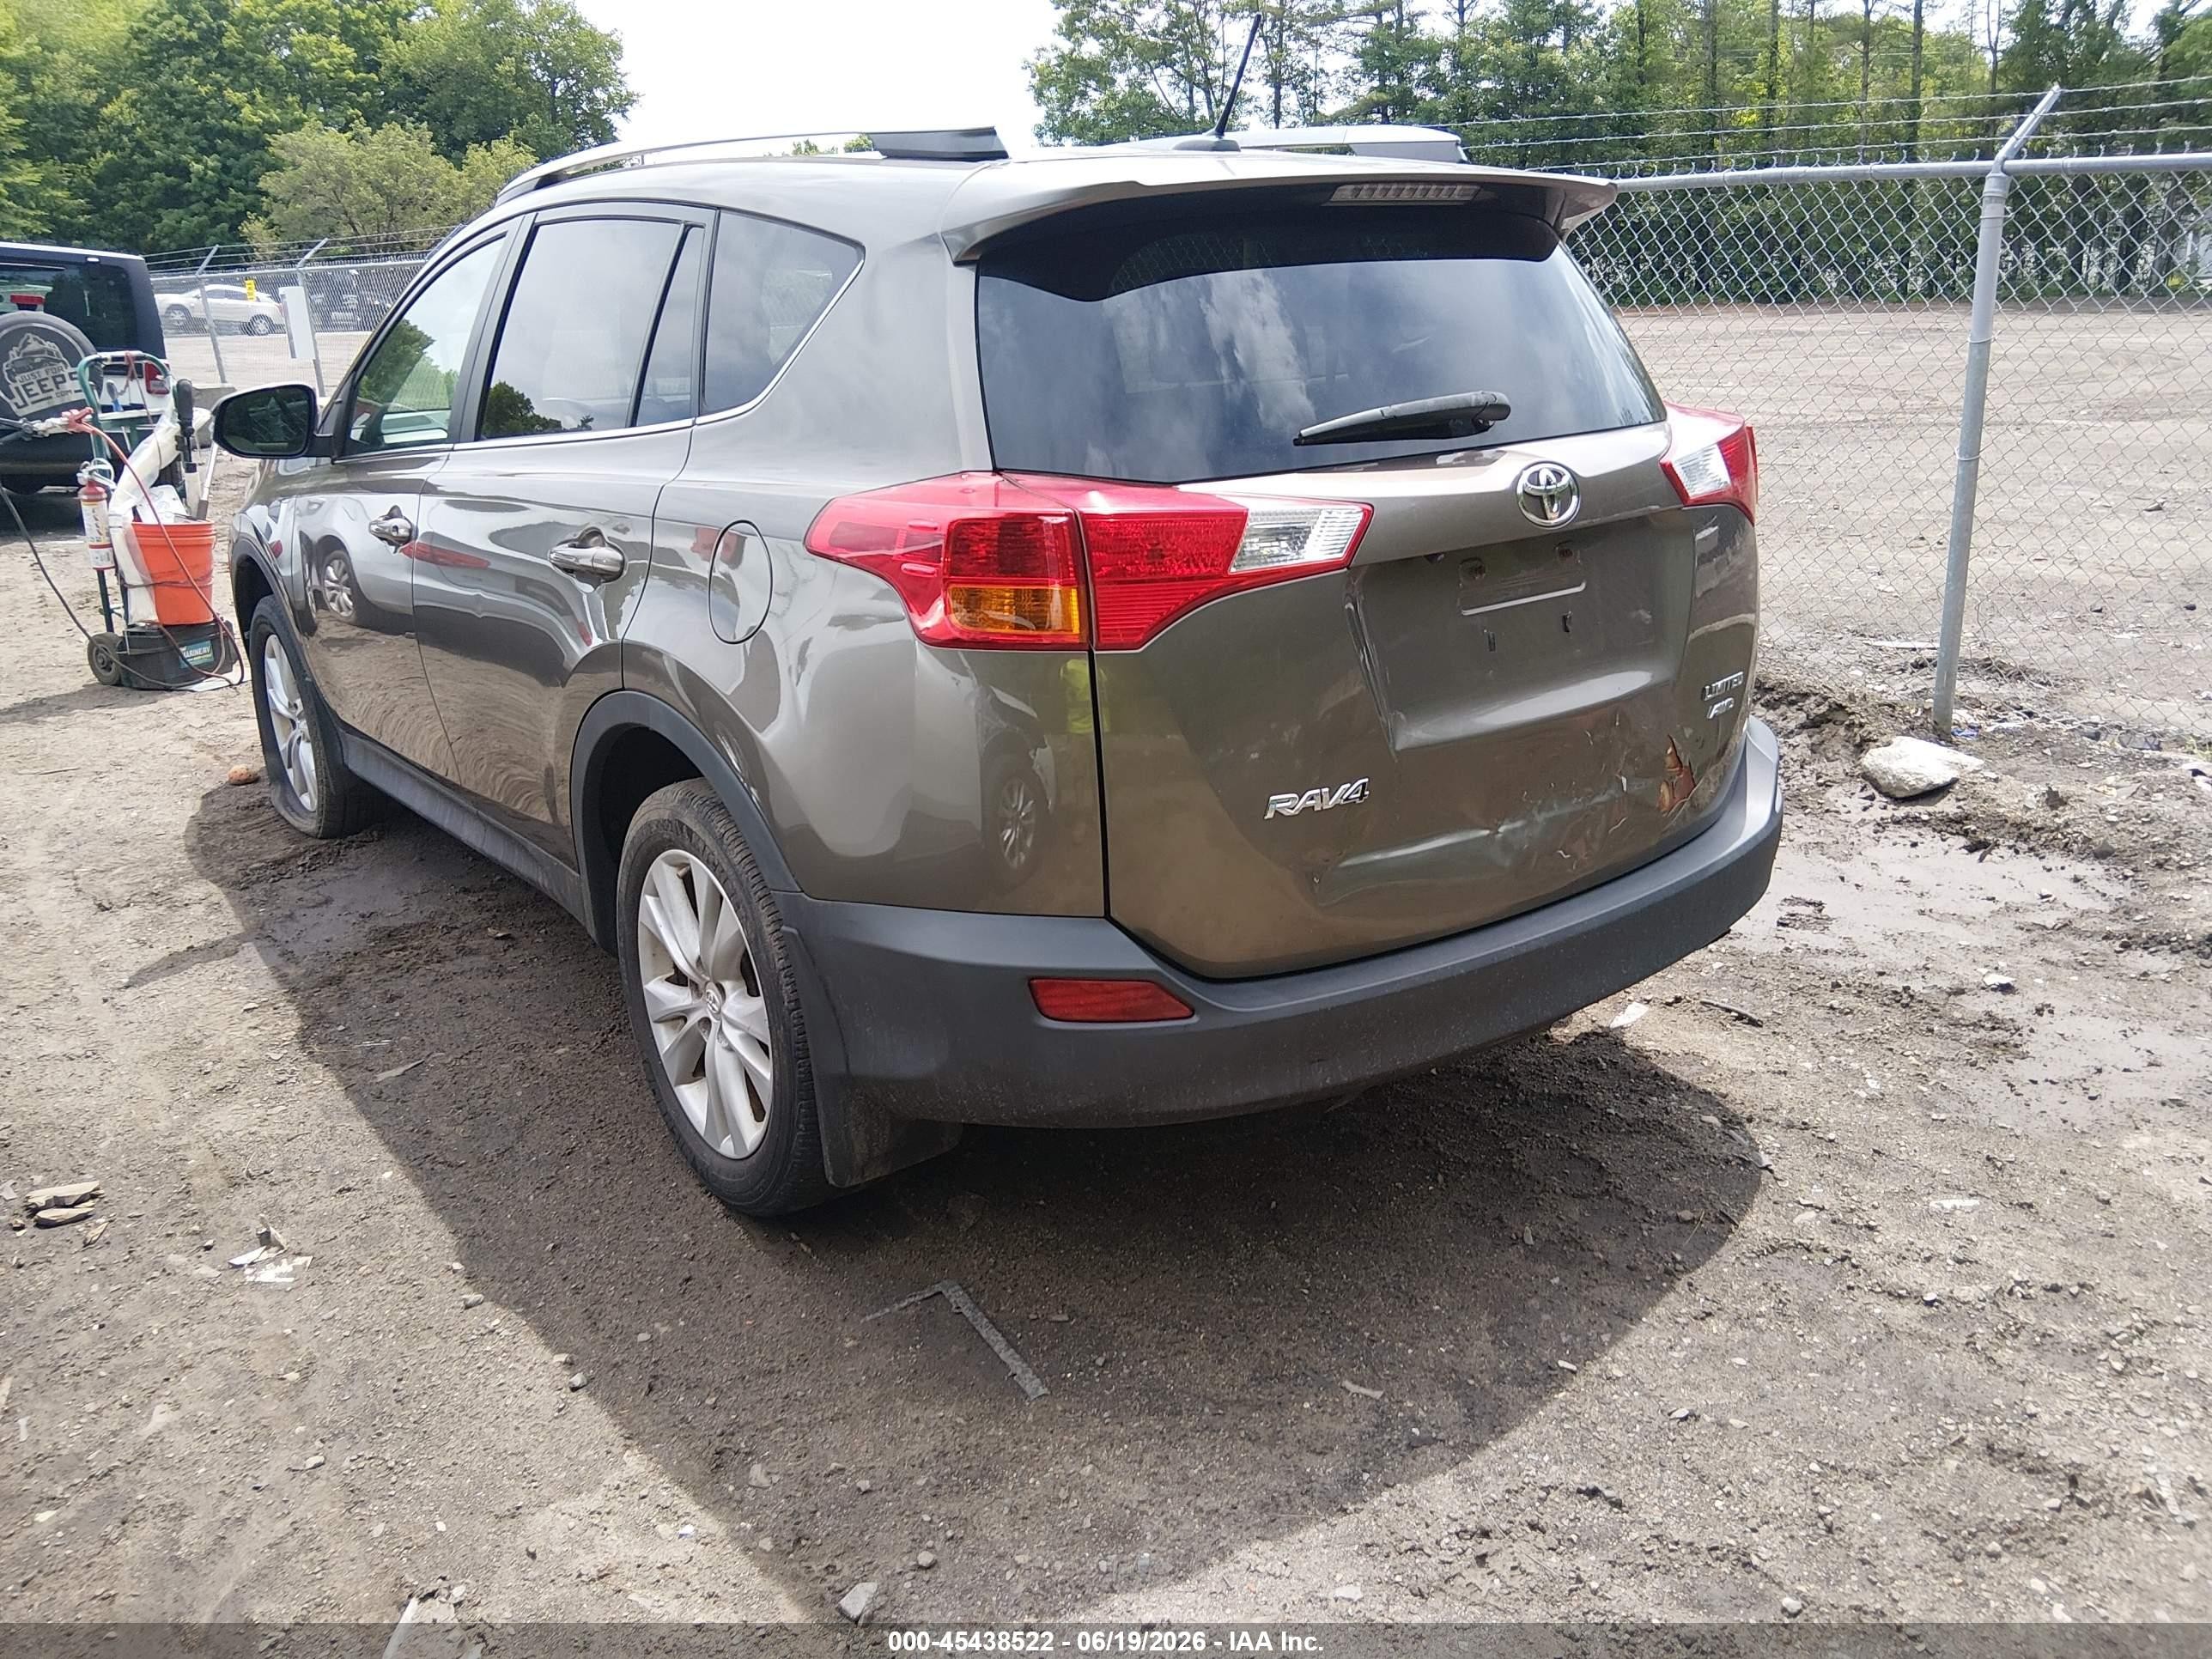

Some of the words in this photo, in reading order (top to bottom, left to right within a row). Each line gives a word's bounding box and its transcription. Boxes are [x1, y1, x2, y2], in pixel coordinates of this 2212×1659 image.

[19, 372, 43, 383] JUST
[44, 366, 66, 375] FOR
[1703, 671, 1744, 702] LIMITED
[1264, 777, 1370, 819] RAV4
